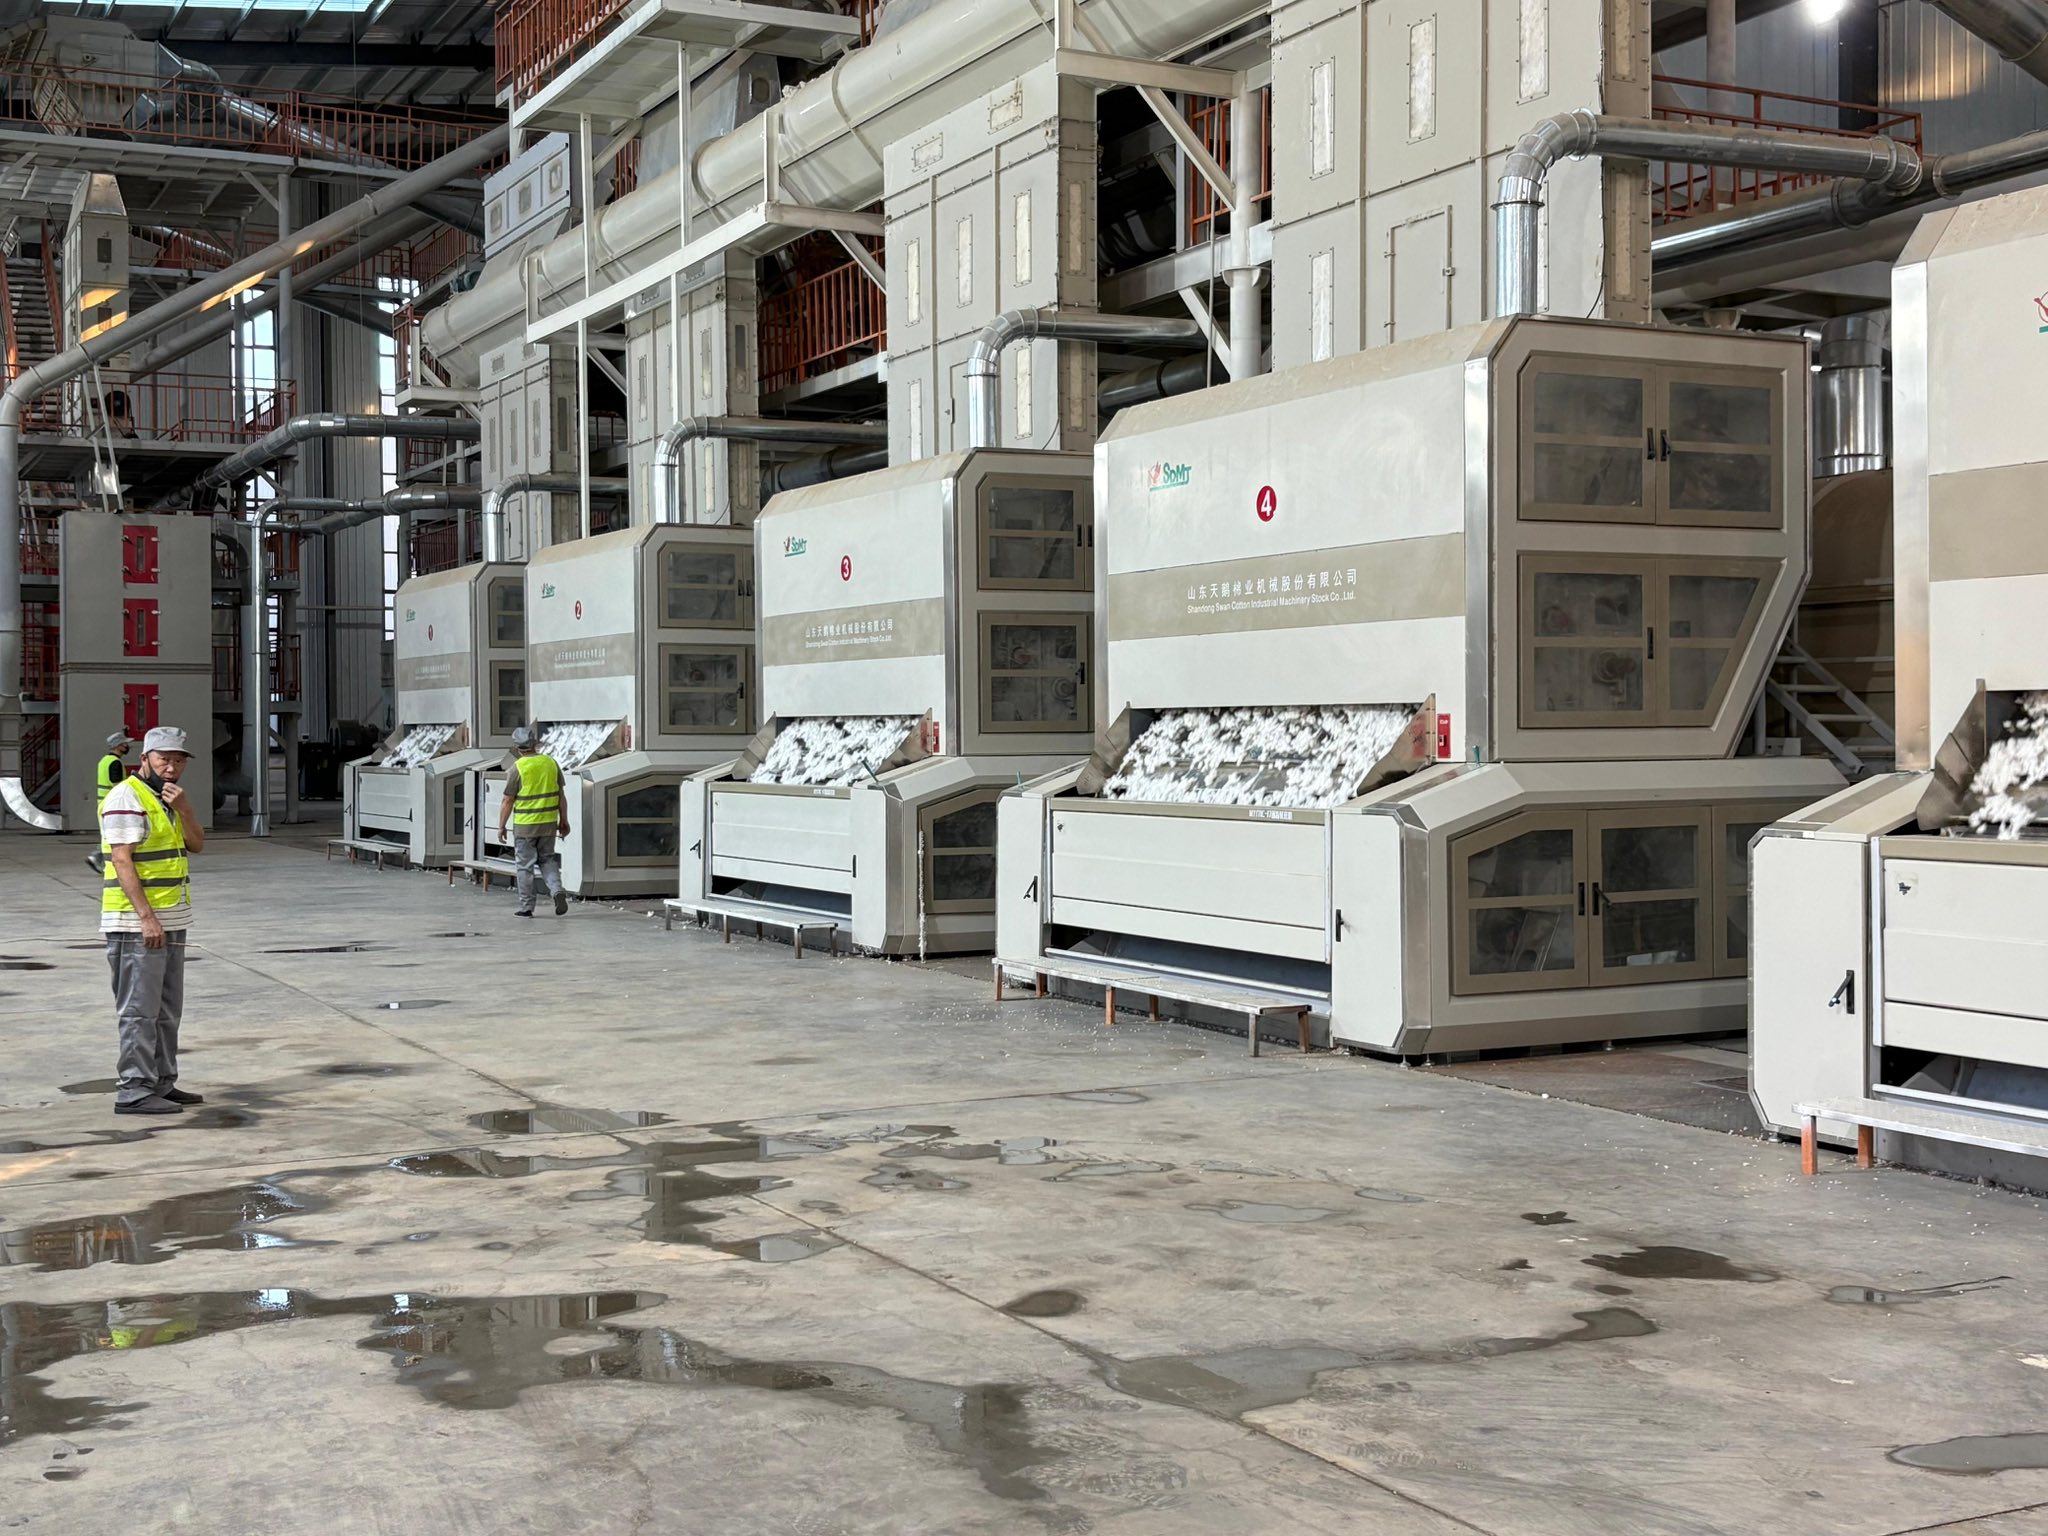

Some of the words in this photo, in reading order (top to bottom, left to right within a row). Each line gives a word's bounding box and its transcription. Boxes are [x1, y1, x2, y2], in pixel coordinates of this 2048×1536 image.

[1260, 490, 1272, 517] 4
[1187, 568, 1357, 600] 山东天鹅棉业机械股份有限公司
[1187, 604, 1215, 614] Shandong
[1215, 602, 1231, 611] Swan
[1231, 600, 1250, 610] Cotton
[1251, 597, 1279, 608] Industrial
[1279, 595, 1311, 606] Machinery
[1311, 593, 1329, 604] Stock
